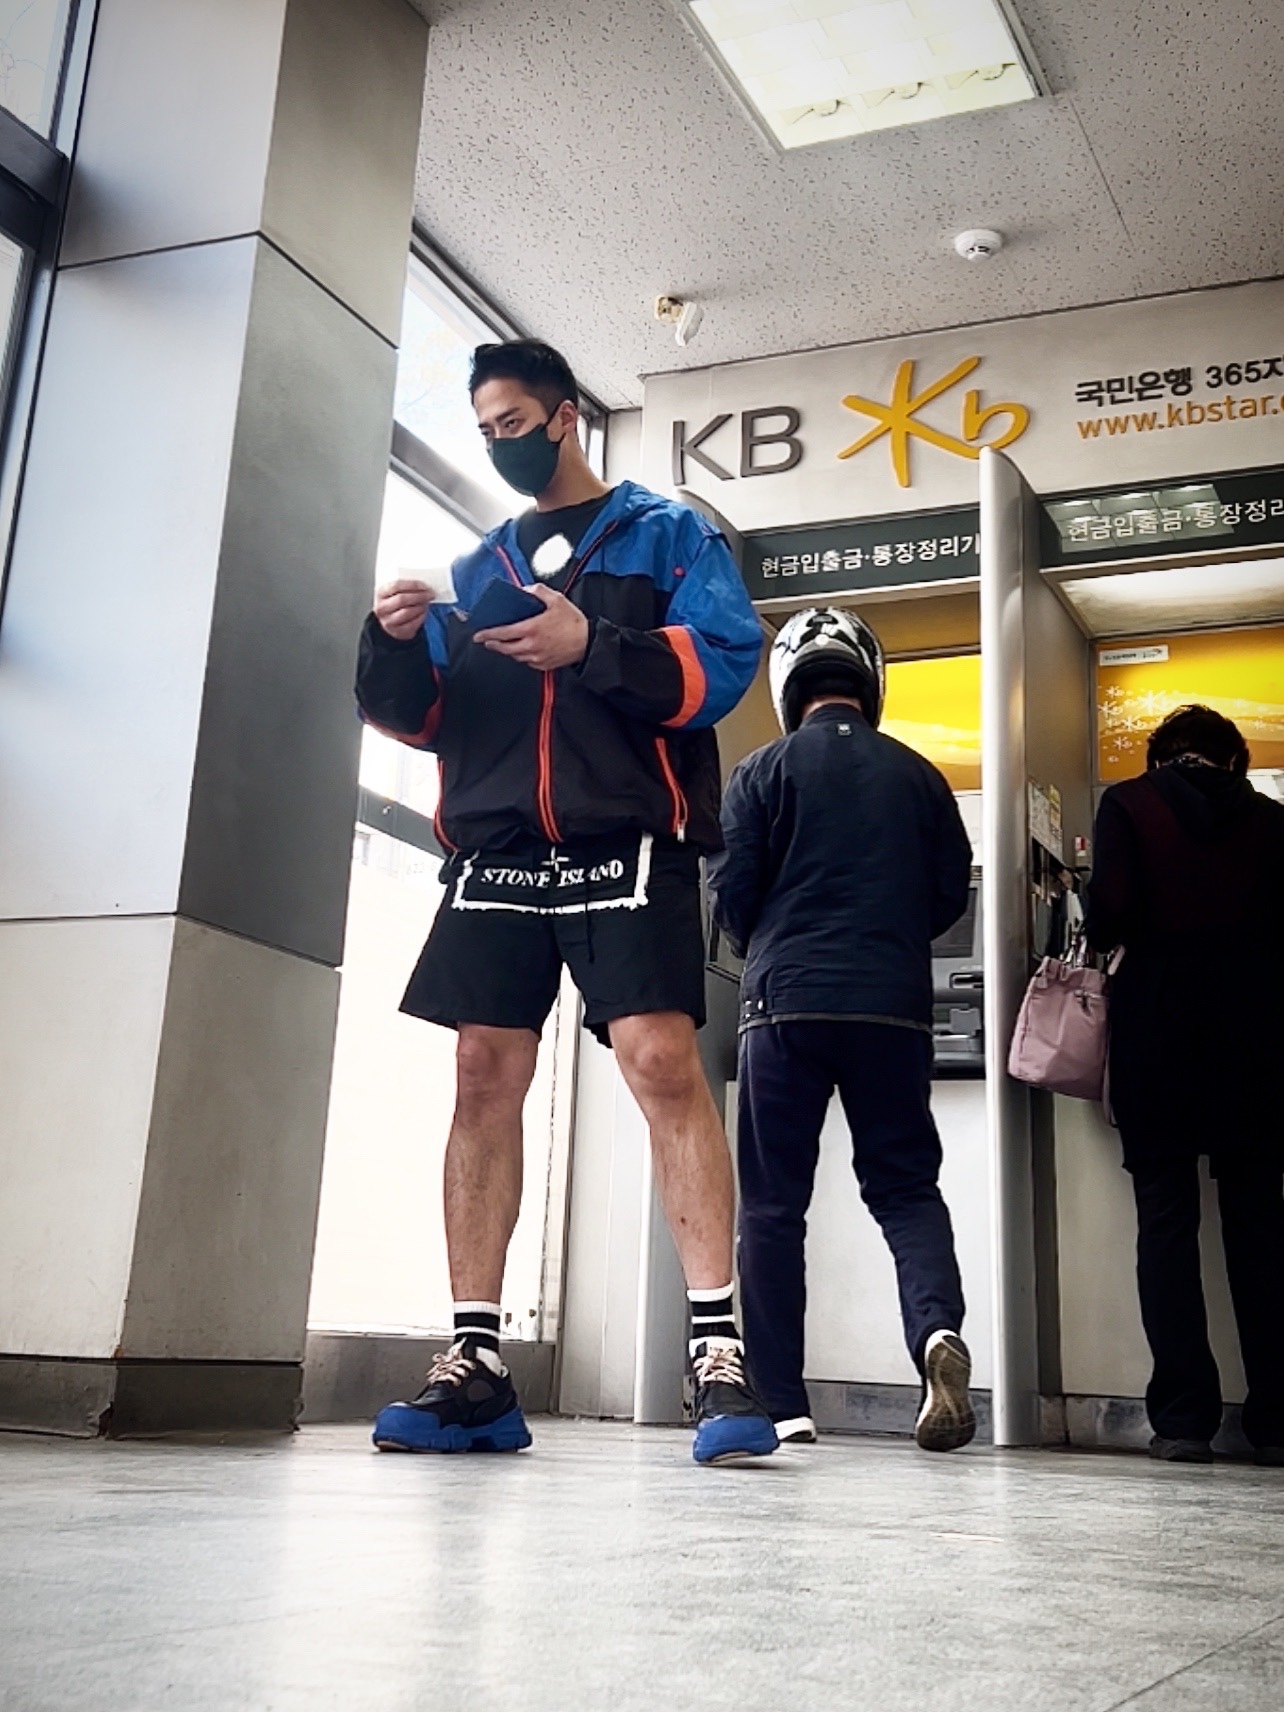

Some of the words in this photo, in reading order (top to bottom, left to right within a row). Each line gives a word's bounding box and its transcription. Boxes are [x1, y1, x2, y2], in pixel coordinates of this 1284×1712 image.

[1075, 366, 1193, 407] 국민은행
[1077, 394, 1284, 439] www.kbstar.
[672, 405, 803, 486] KB
[481, 867, 551, 888] STONE
[557, 859, 624, 887] ISLAND
